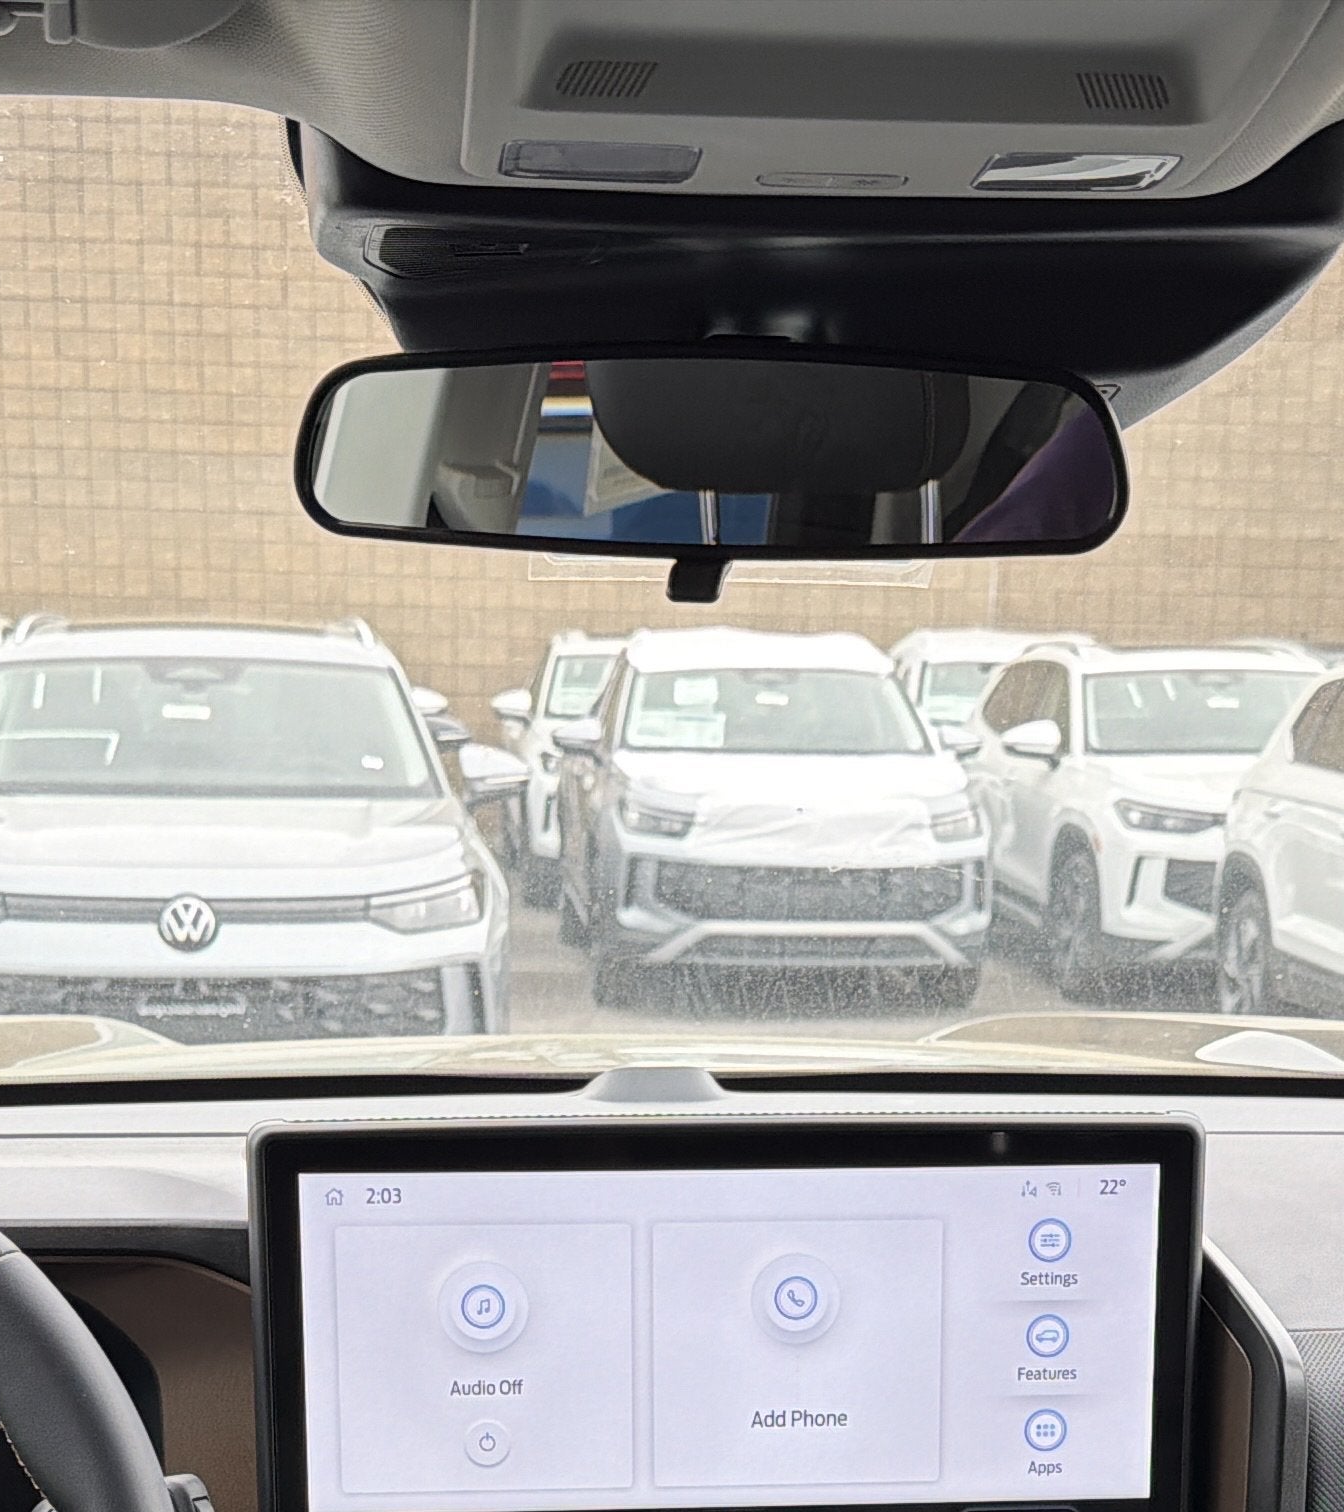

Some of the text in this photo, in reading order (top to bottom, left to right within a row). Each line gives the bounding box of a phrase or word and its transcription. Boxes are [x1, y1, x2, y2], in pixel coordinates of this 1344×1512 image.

[366, 1188, 402, 1204] 2:03
[1099, 1179, 1126, 1196] 22°
[1020, 1271, 1078, 1288] Settings
[1017, 1366, 1077, 1382] Features
[450, 1379, 524, 1396] Audio Off
[751, 1409, 848, 1428] Add Phone
[1027, 1460, 1063, 1476] Apps
